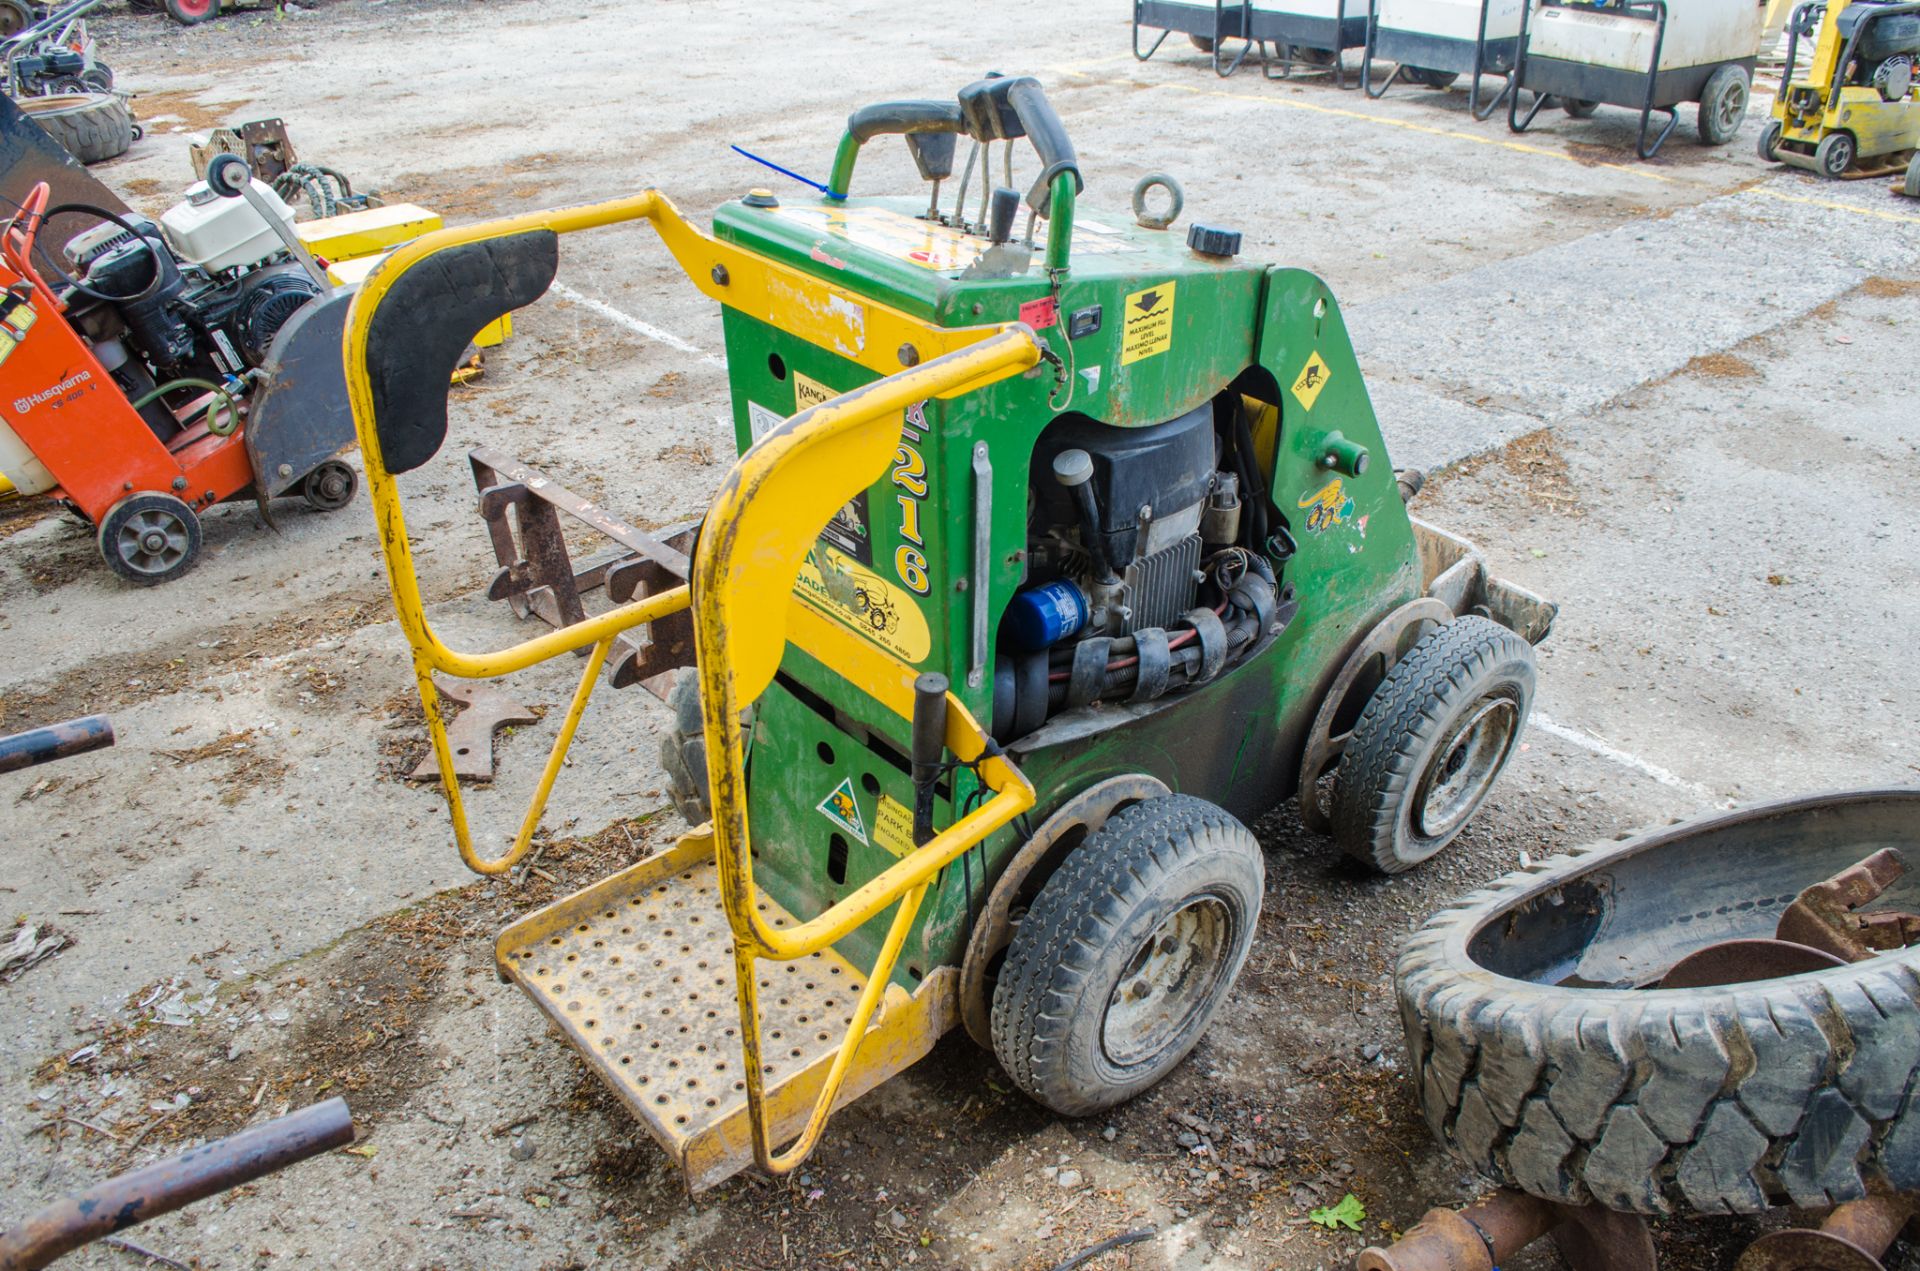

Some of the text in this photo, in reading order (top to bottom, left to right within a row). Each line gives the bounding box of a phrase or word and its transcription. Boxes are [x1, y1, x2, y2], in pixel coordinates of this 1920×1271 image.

[1129, 322, 1157, 336] MAXIMUM
[1140, 330, 1154, 340] LEVEL
[27, 370, 91, 407] Husqvarna
[876, 823, 911, 850] ENGAGED
[877, 809, 914, 840] PARK B
